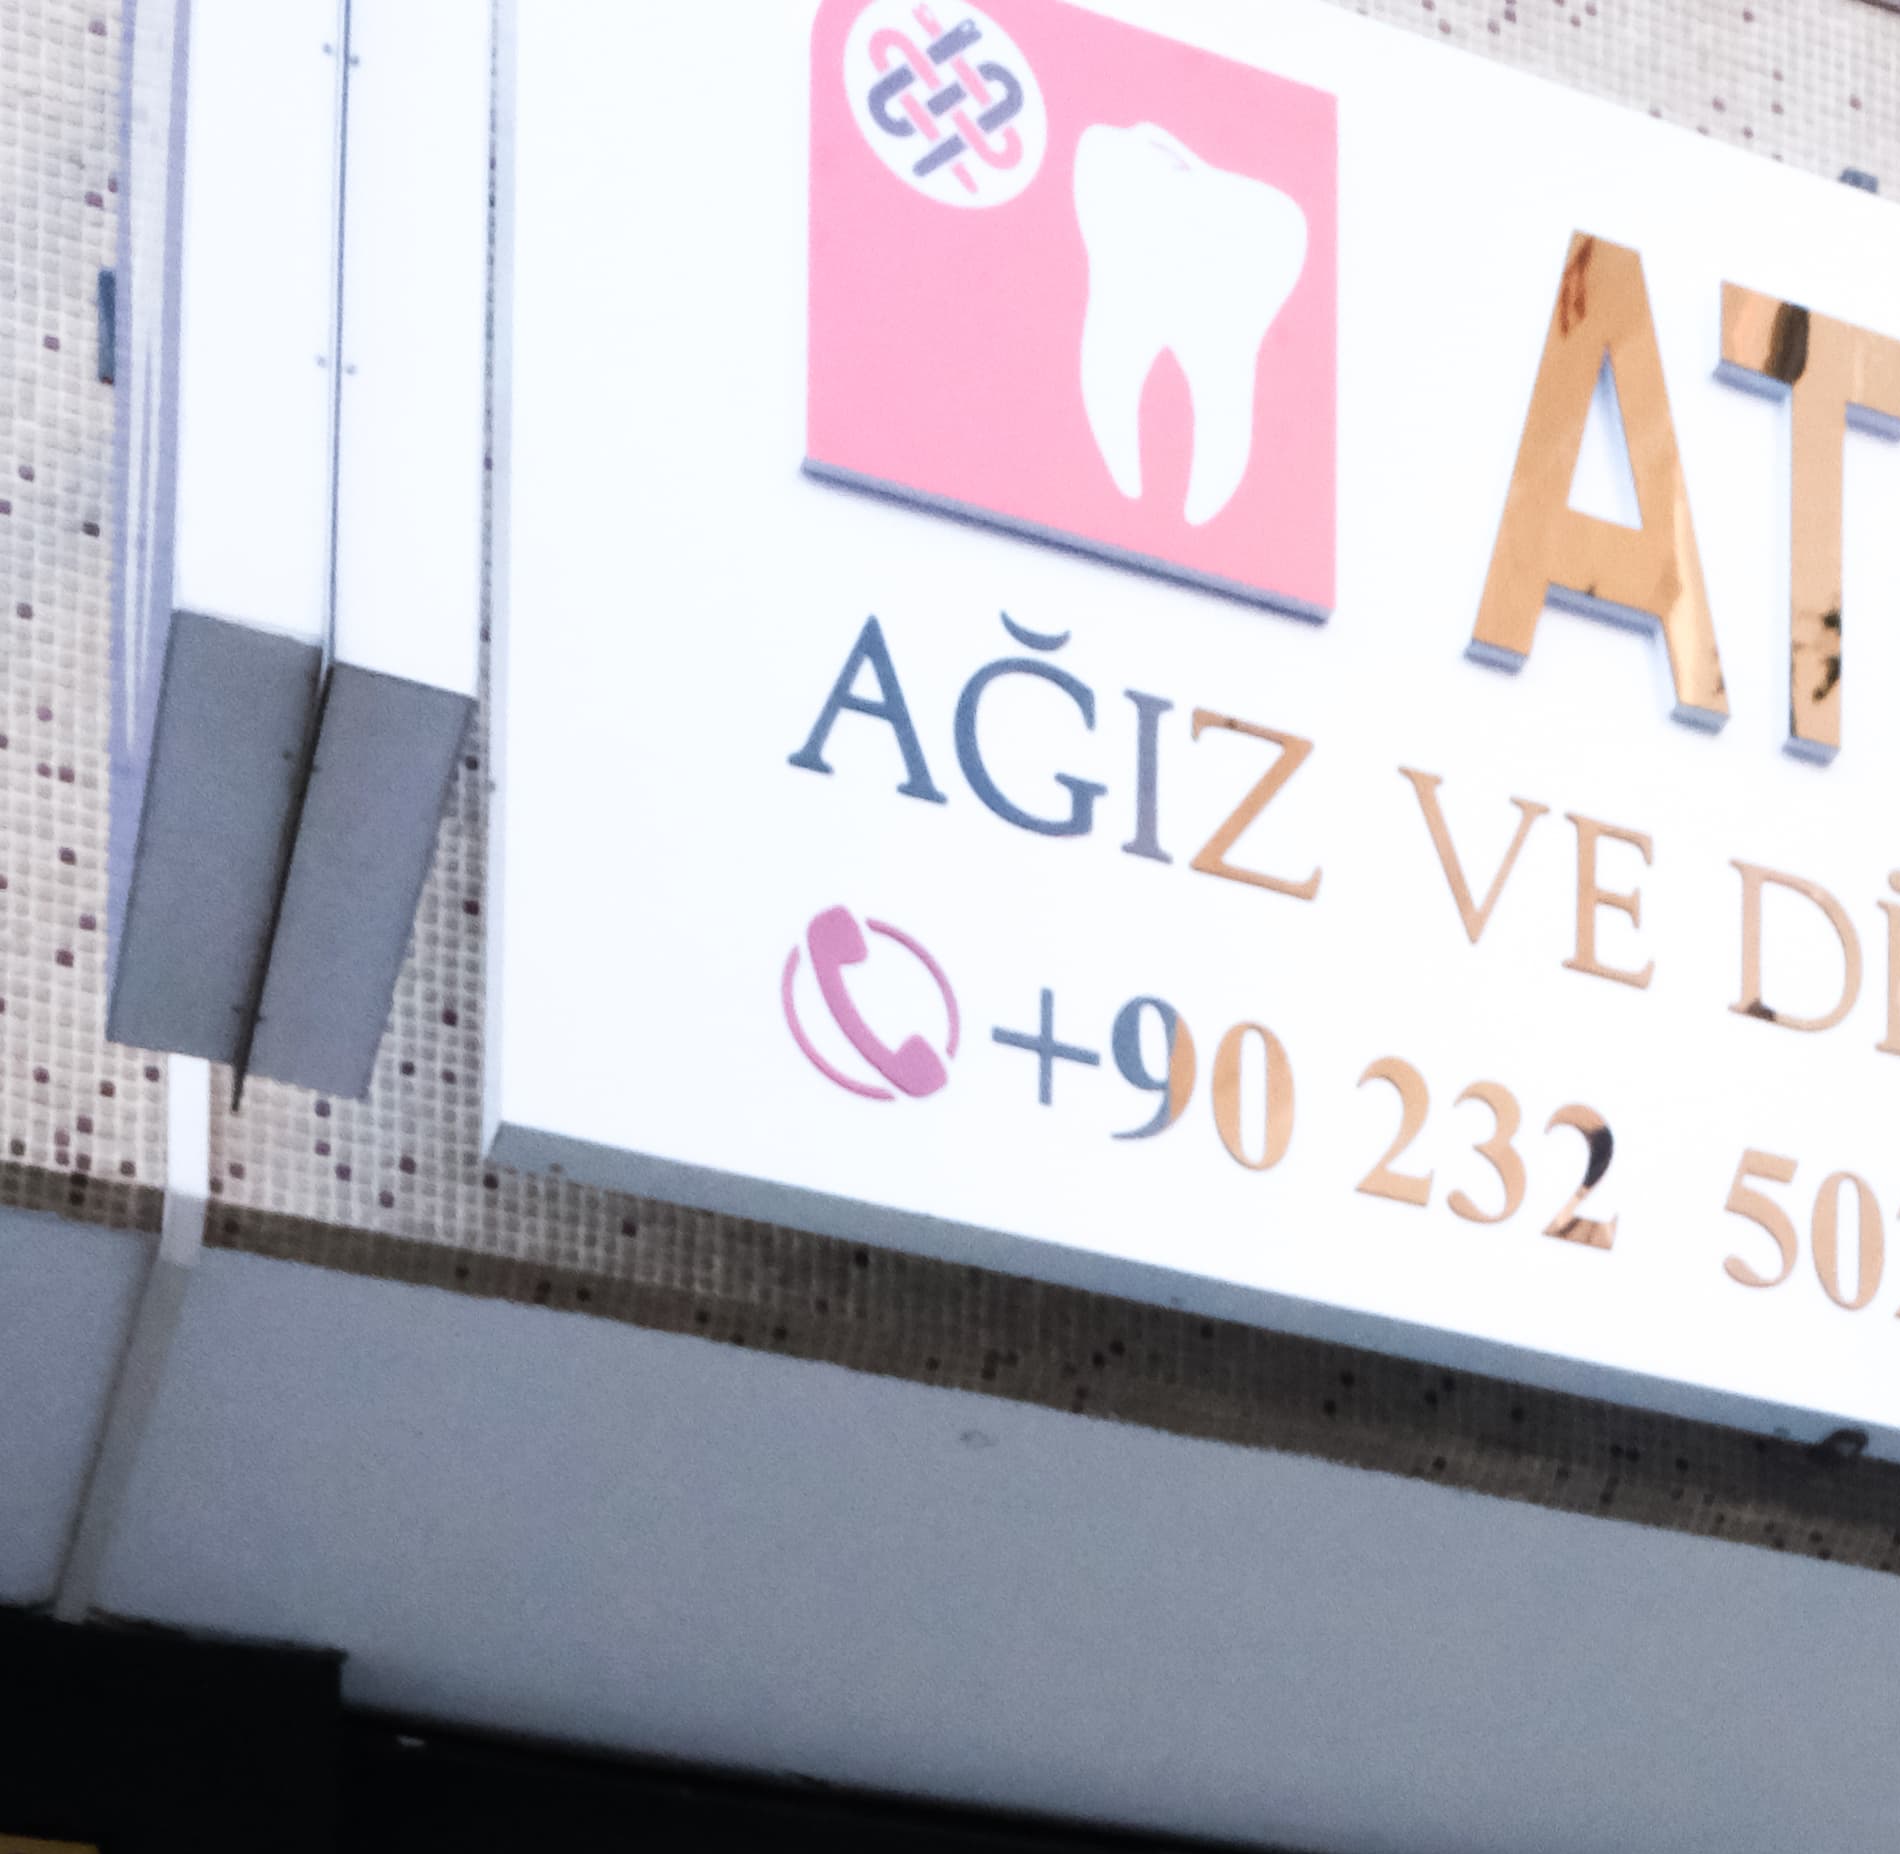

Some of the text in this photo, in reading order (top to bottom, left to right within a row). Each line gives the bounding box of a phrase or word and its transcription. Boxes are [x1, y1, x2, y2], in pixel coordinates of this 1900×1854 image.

[787, 612, 1321, 900] AĞIZ
[1400, 765, 1656, 988] VE
[991, 987, 1294, 1171] +90
[1356, 1056, 1619, 1250] 232
